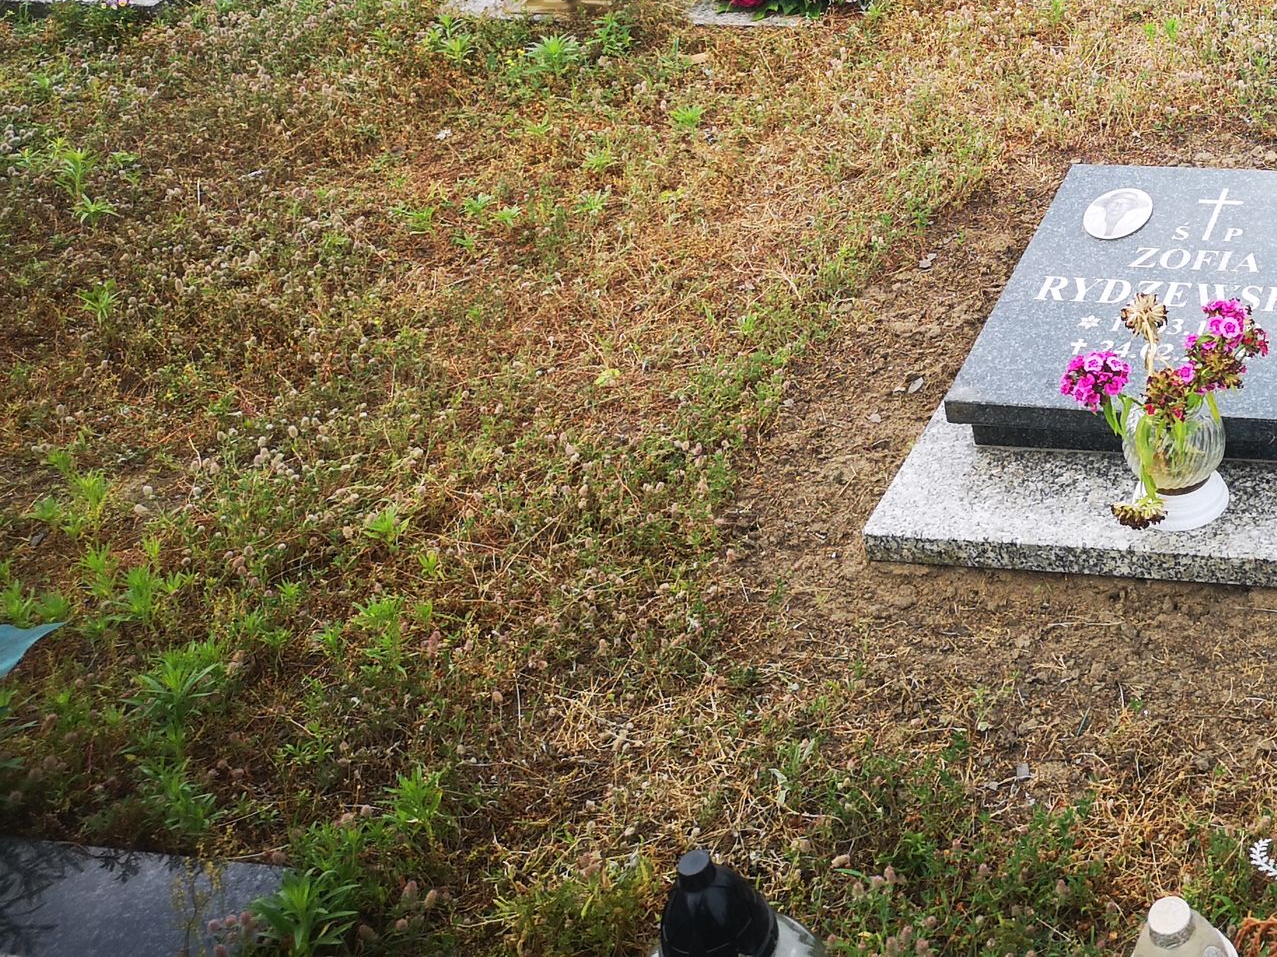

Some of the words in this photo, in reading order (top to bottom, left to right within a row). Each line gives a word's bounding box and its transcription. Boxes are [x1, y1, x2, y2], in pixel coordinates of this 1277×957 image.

[1171, 222, 1191, 241] Ś
[1223, 227, 1244, 242] P
[1128, 247, 1260, 274] ZOFIA
